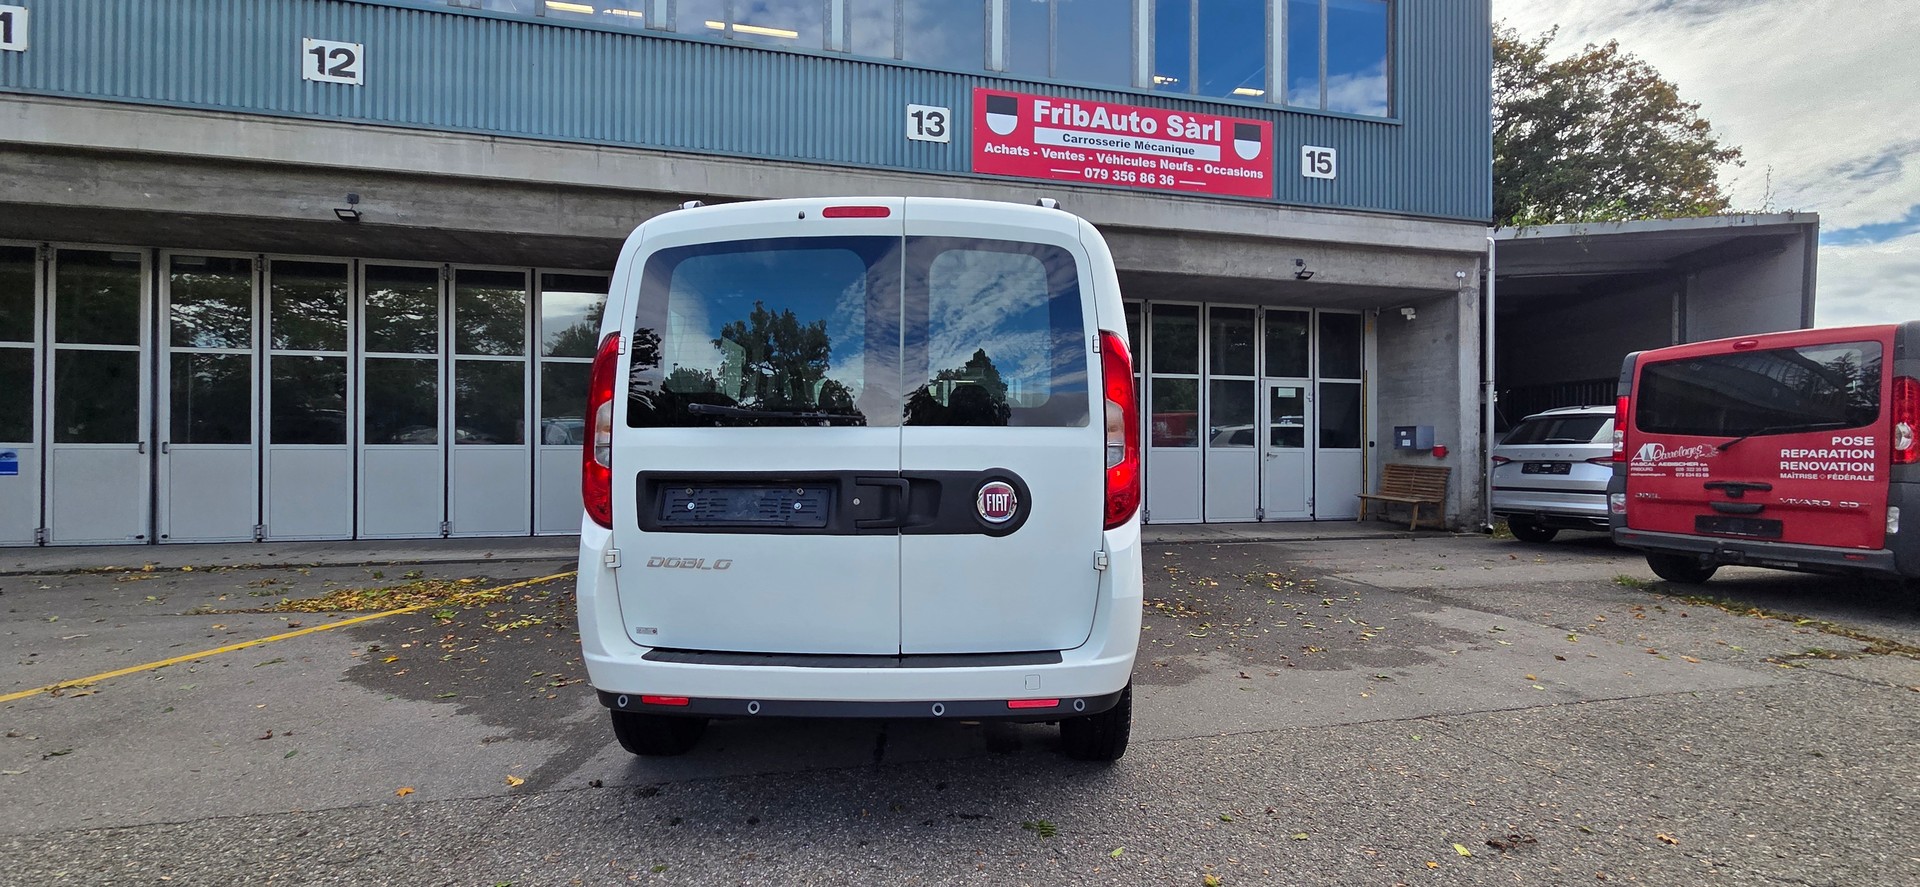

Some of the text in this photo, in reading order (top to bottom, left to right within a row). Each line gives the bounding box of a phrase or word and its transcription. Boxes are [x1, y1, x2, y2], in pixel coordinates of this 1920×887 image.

[308, 45, 356, 78] 12
[911, 110, 945, 137] 13
[1034, 99, 1221, 142] FribAuto Sàrl
[1062, 133, 1195, 156] Carrosserie Mécanique
[984, 142, 1030, 156] Achats
[1041, 148, 1085, 162] Ventes
[1096, 152, 1157, 169] Véhicules
[1159, 159, 1194, 172] Neufs
[1204, 163, 1264, 179] Occasions
[1305, 150, 1332, 174] 15
[1084, 167, 1175, 186] 079 356 86 36
[1831, 436, 1875, 446] POSE
[1780, 449, 1875, 459] REPARATION
[1780, 461, 1875, 472] RENOVATION
[1780, 472, 1875, 482] MAÎTRISE FÉDÉRALE
[986, 493, 1009, 512] FIAT
[1780, 497, 1831, 507] VIVARO
[646, 556, 733, 570] DOBLO
